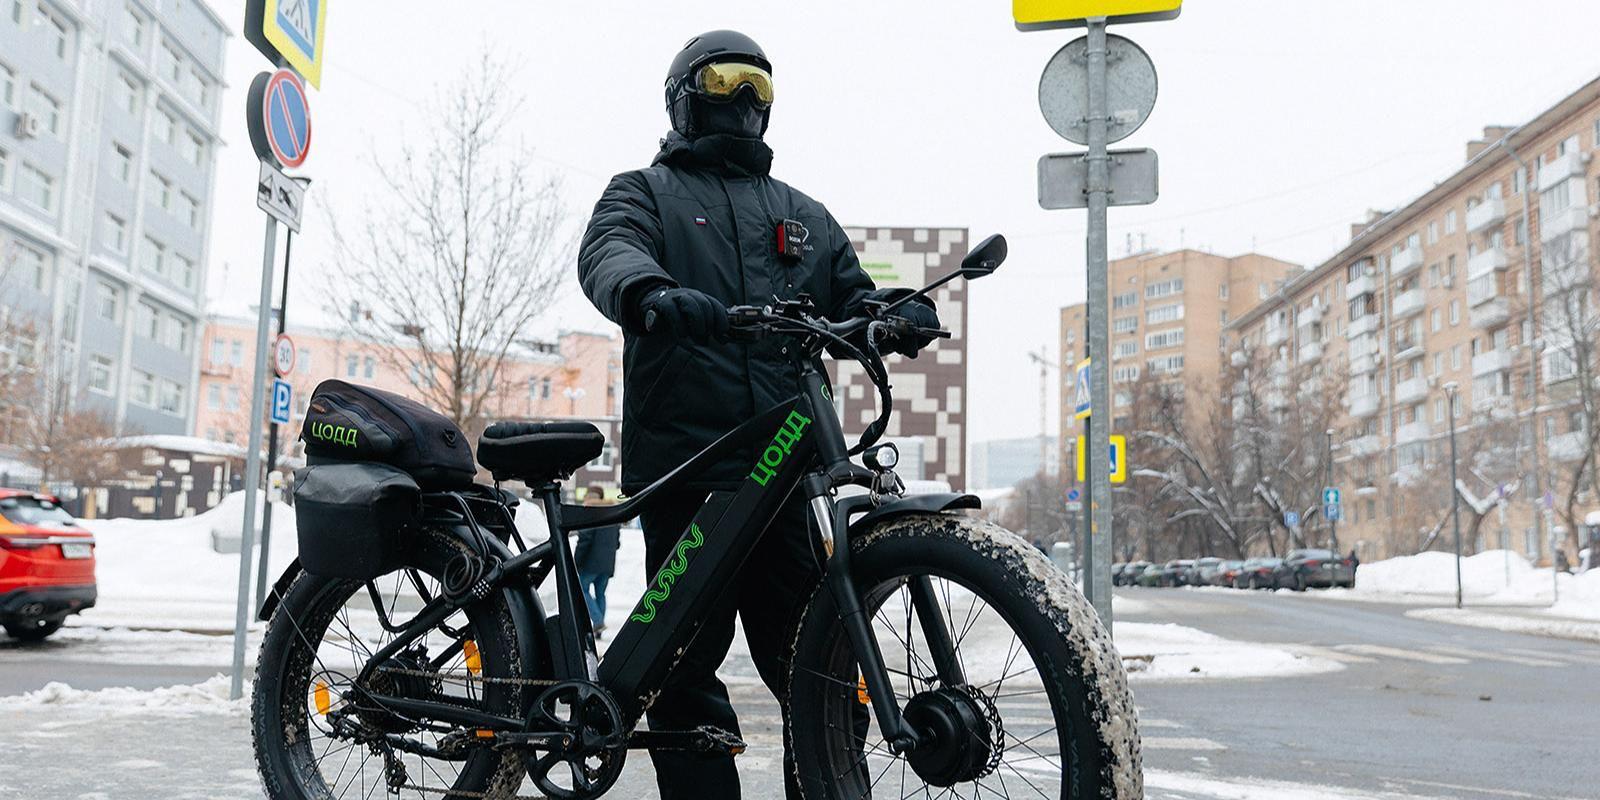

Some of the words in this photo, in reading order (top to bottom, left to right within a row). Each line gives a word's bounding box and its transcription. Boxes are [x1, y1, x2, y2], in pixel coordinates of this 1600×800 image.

[312, 421, 358, 448] ЦОДД
[750, 410, 811, 486] ЦОДД
[263, 753, 281, 793] CHAO
[1070, 738, 1080, 798] YANG
